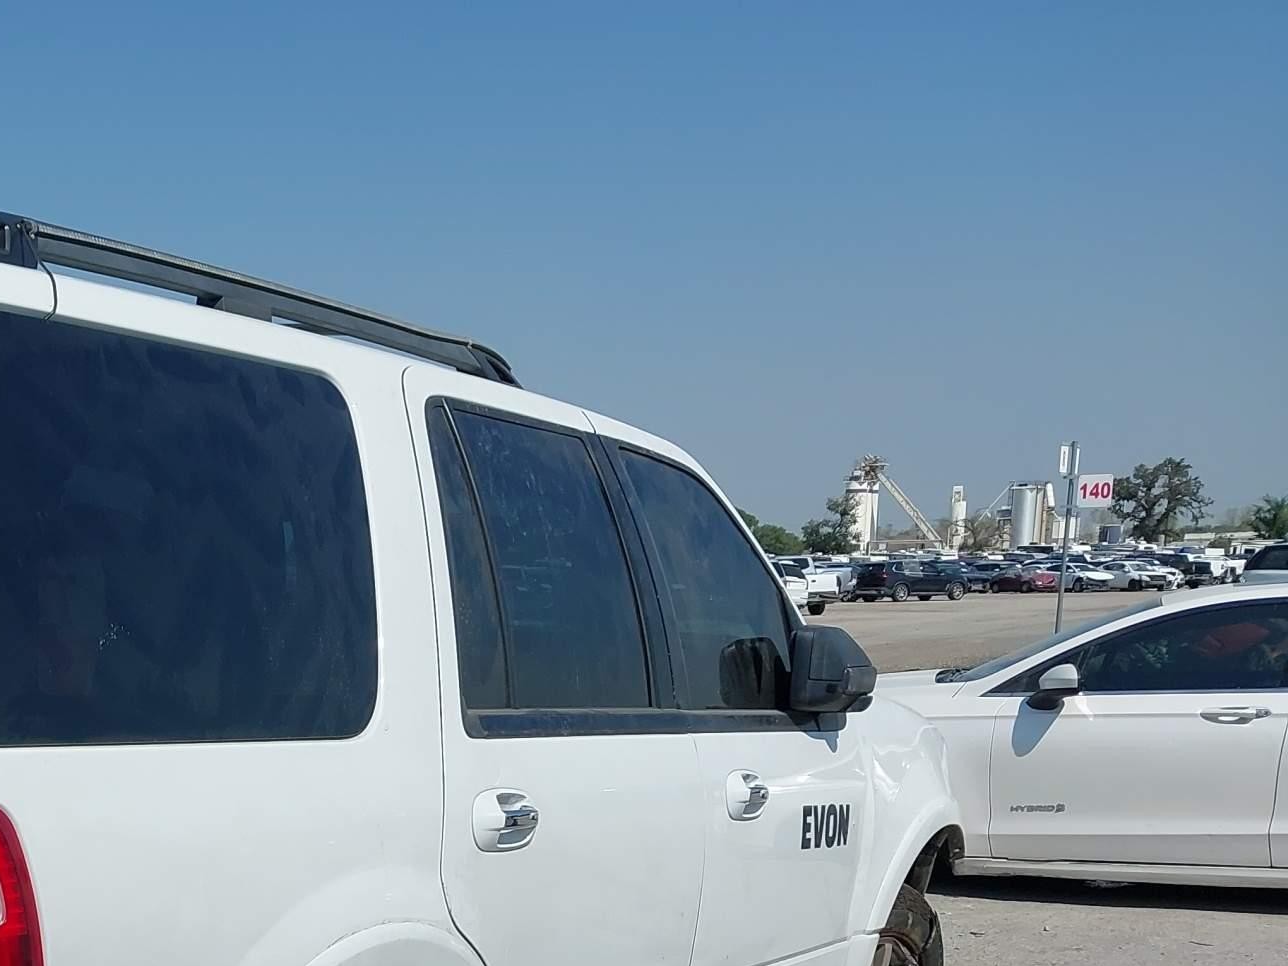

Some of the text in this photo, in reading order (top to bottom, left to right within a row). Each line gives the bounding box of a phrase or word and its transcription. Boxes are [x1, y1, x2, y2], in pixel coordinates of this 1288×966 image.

[1080, 482, 1111, 499] 140
[1010, 804, 1056, 813] HYBRID
[801, 803, 850, 850] EVON
